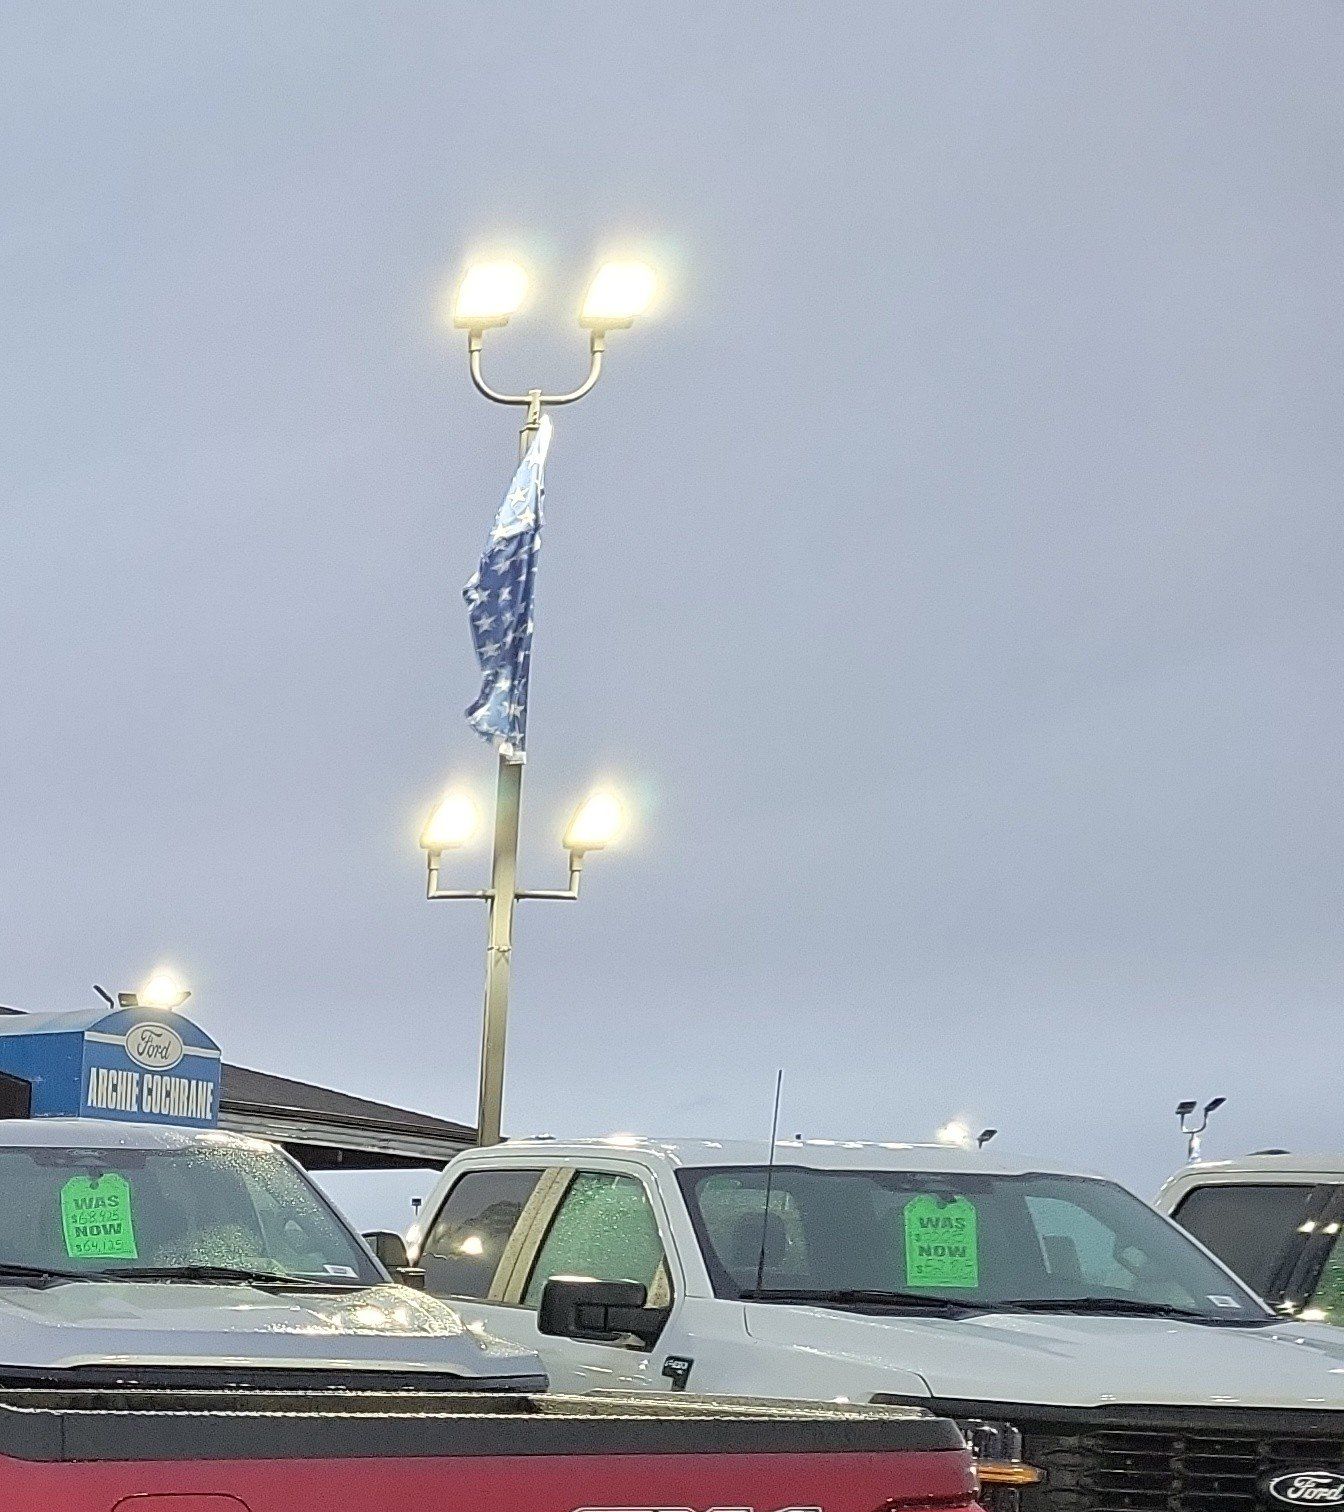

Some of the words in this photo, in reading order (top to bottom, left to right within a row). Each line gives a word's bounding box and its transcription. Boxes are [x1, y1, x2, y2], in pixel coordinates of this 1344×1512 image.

[136, 1029, 171, 1060] Ford
[87, 1067, 140, 1112] ARCHIE
[142, 1073, 214, 1120] COCHRANE
[73, 1195, 120, 1211] WAS
[75, 1222, 122, 1238] NOW
[919, 1216, 966, 1230] WAS
[918, 1244, 966, 1258] NOW
[1286, 1476, 1344, 1500] Ford
